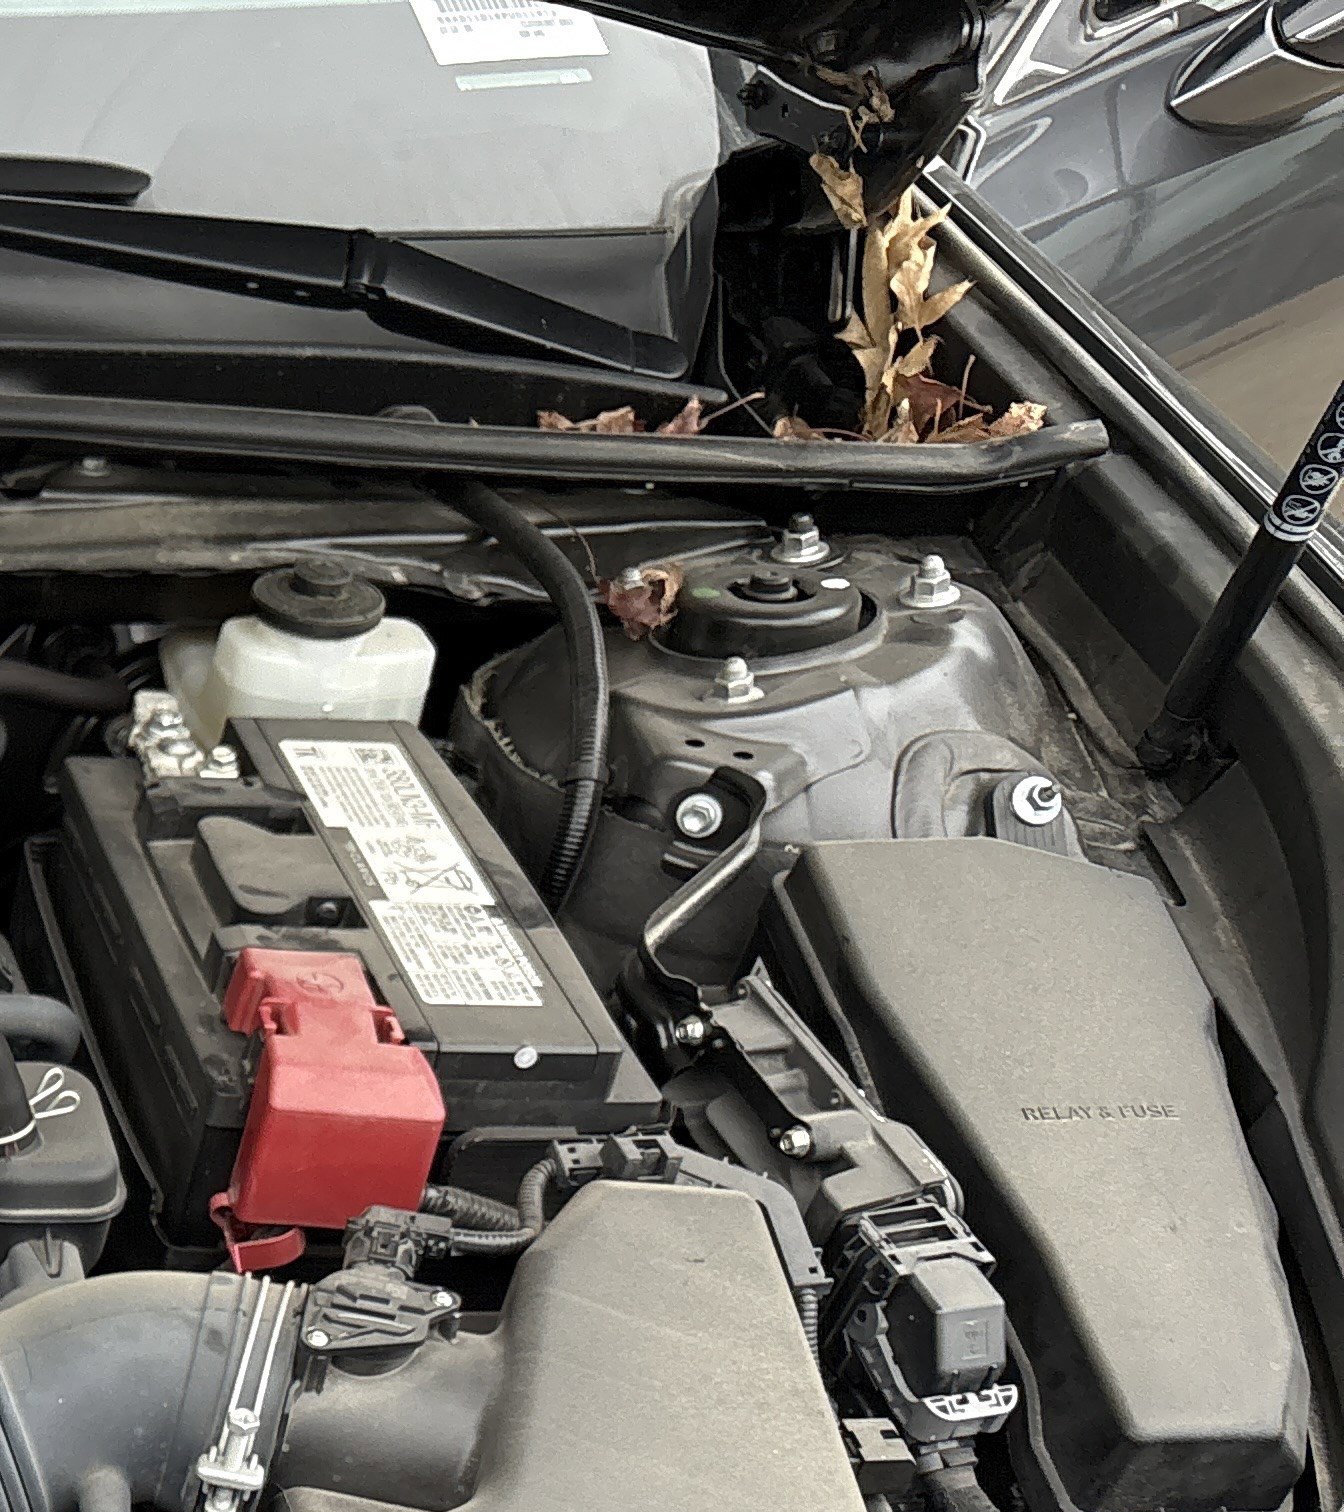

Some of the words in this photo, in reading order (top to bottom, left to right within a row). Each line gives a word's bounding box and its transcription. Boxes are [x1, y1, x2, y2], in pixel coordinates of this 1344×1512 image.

[1021, 1105, 1092, 1121] RELAY
[1097, 1105, 1115, 1119] &
[1118, 1104, 1180, 1119] FUSE
